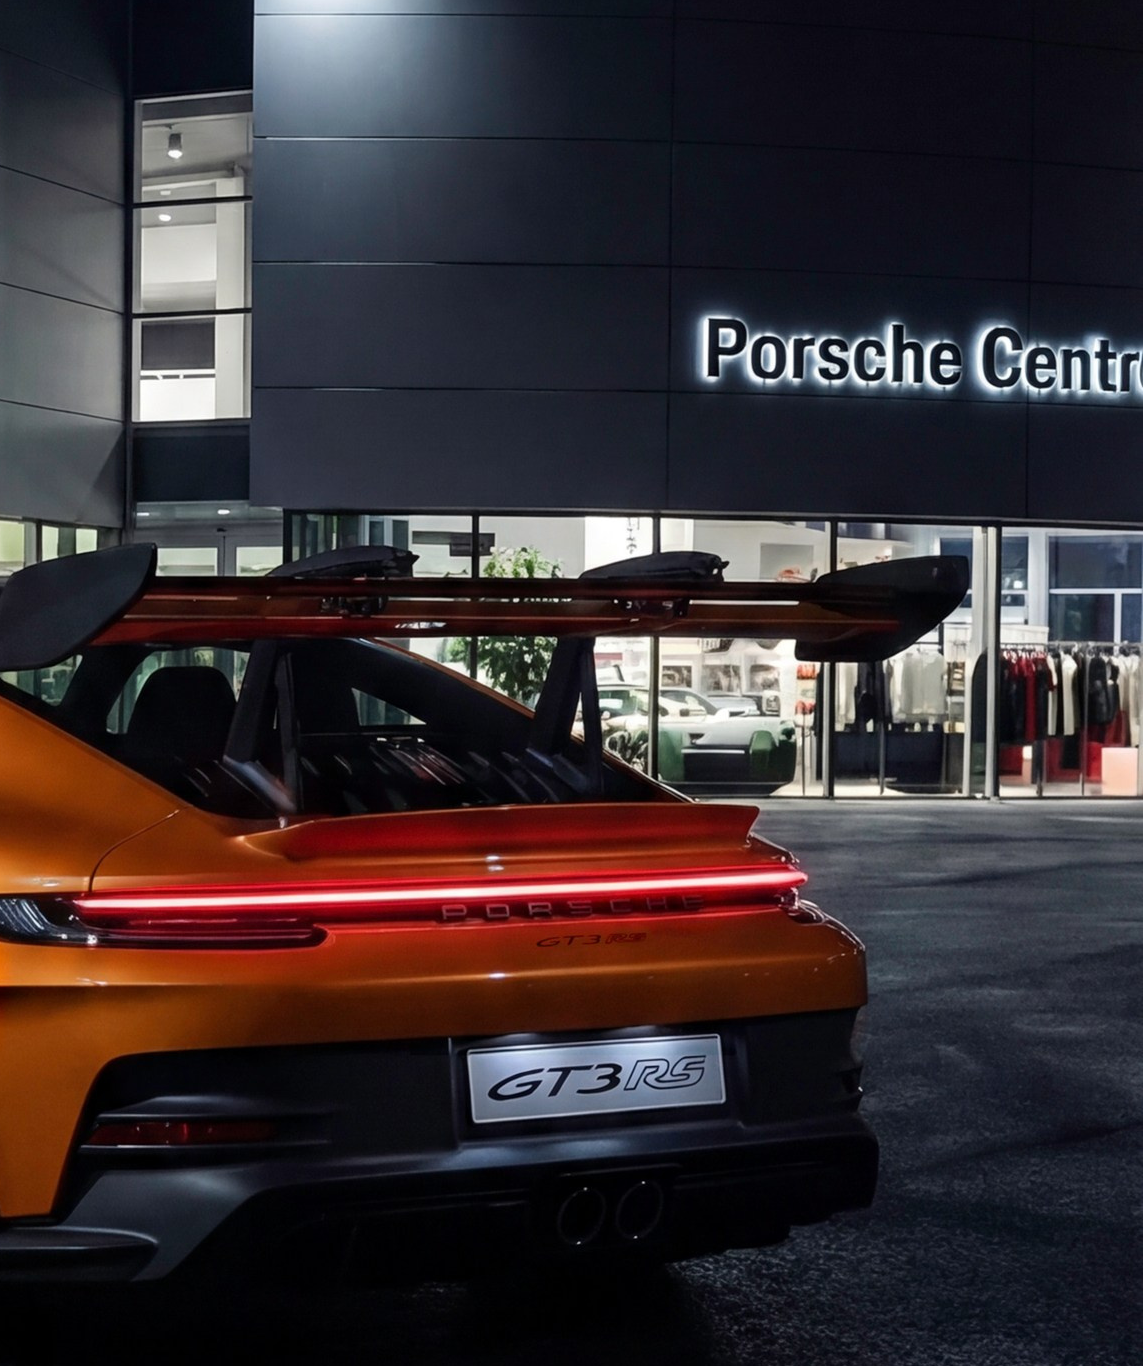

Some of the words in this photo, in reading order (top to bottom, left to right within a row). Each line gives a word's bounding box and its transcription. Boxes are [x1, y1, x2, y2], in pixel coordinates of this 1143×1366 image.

[704, 317, 963, 386] Porsche
[981, 325, 1143, 393] Centr
[441, 894, 705, 921] PORSCHE
